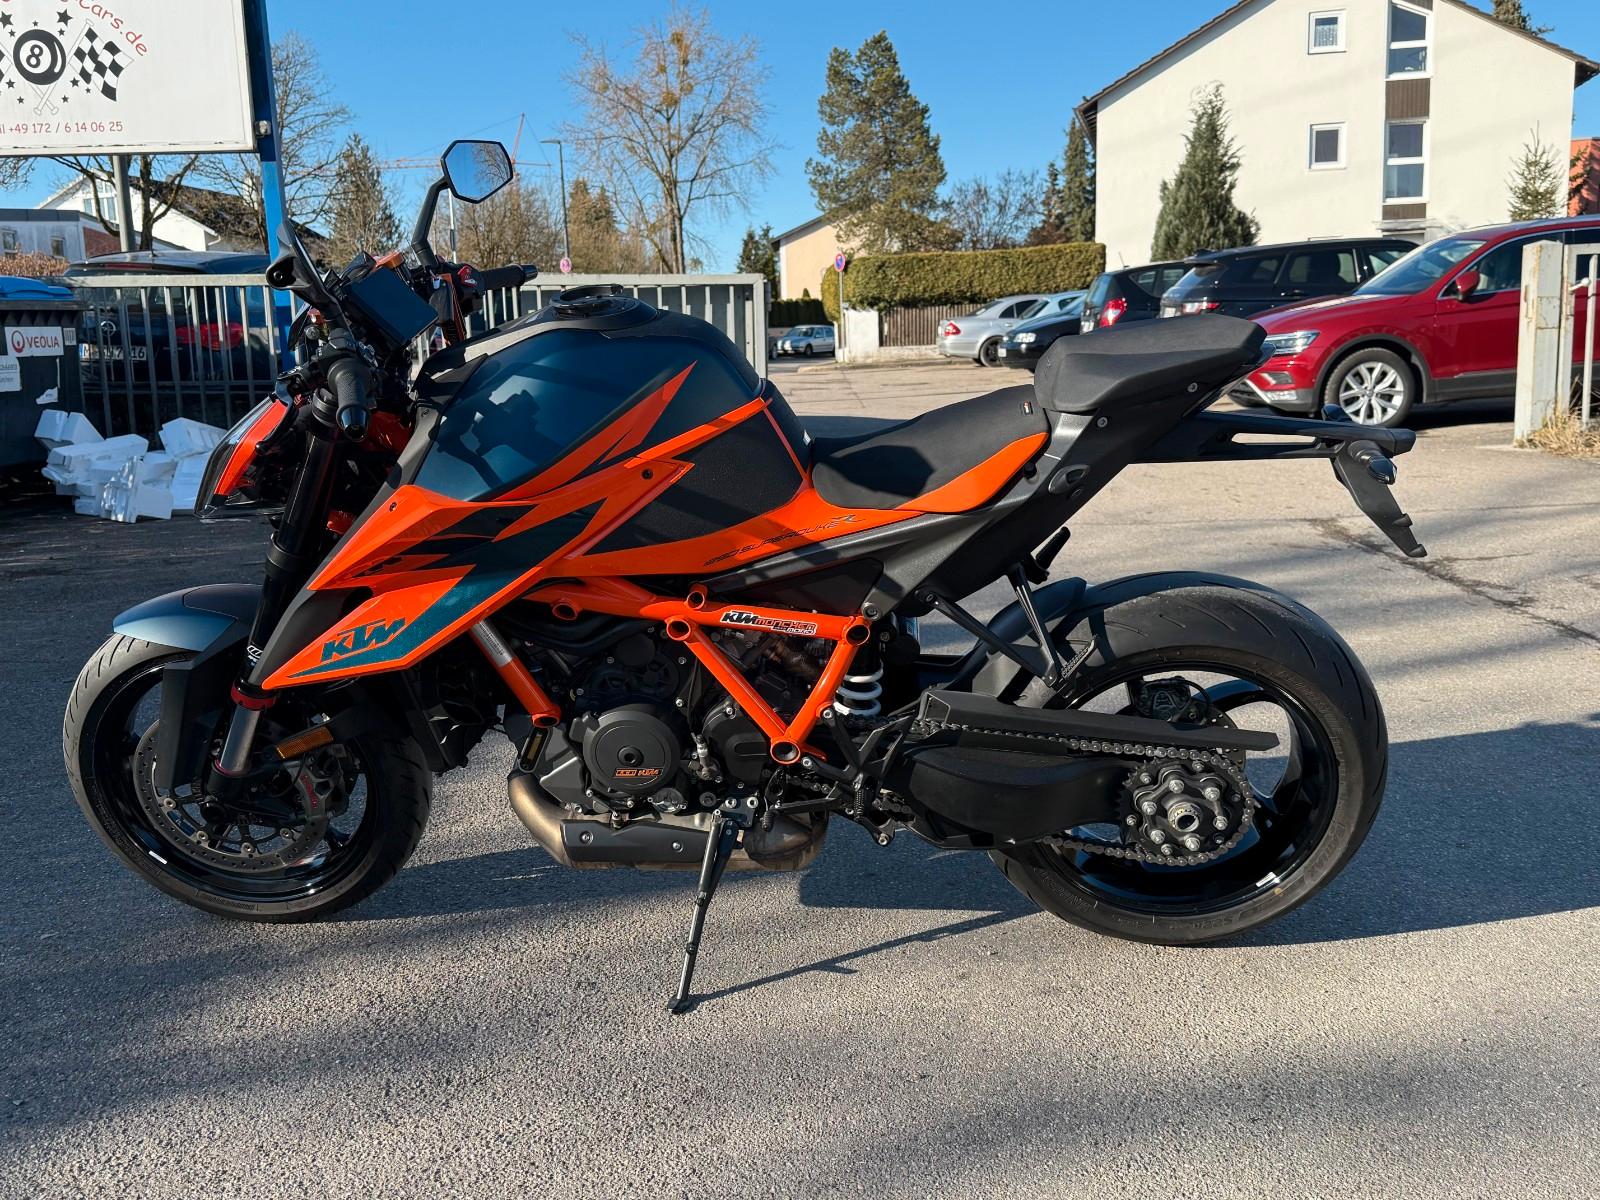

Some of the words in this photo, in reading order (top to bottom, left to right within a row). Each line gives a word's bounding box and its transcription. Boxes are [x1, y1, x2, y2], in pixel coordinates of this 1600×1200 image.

[25, 44, 44, 69] 8
[8, 122, 28, 134] +49
[31, 122, 52, 134] 172
[64, 121, 72, 133] 6
[75, 121, 88, 133] 14
[90, 121, 105, 133] 06
[108, 120, 124, 132] 25
[26, 336, 60, 349] VEOLIA
[721, 610, 759, 625] KTM
[320, 617, 406, 663] KTM
